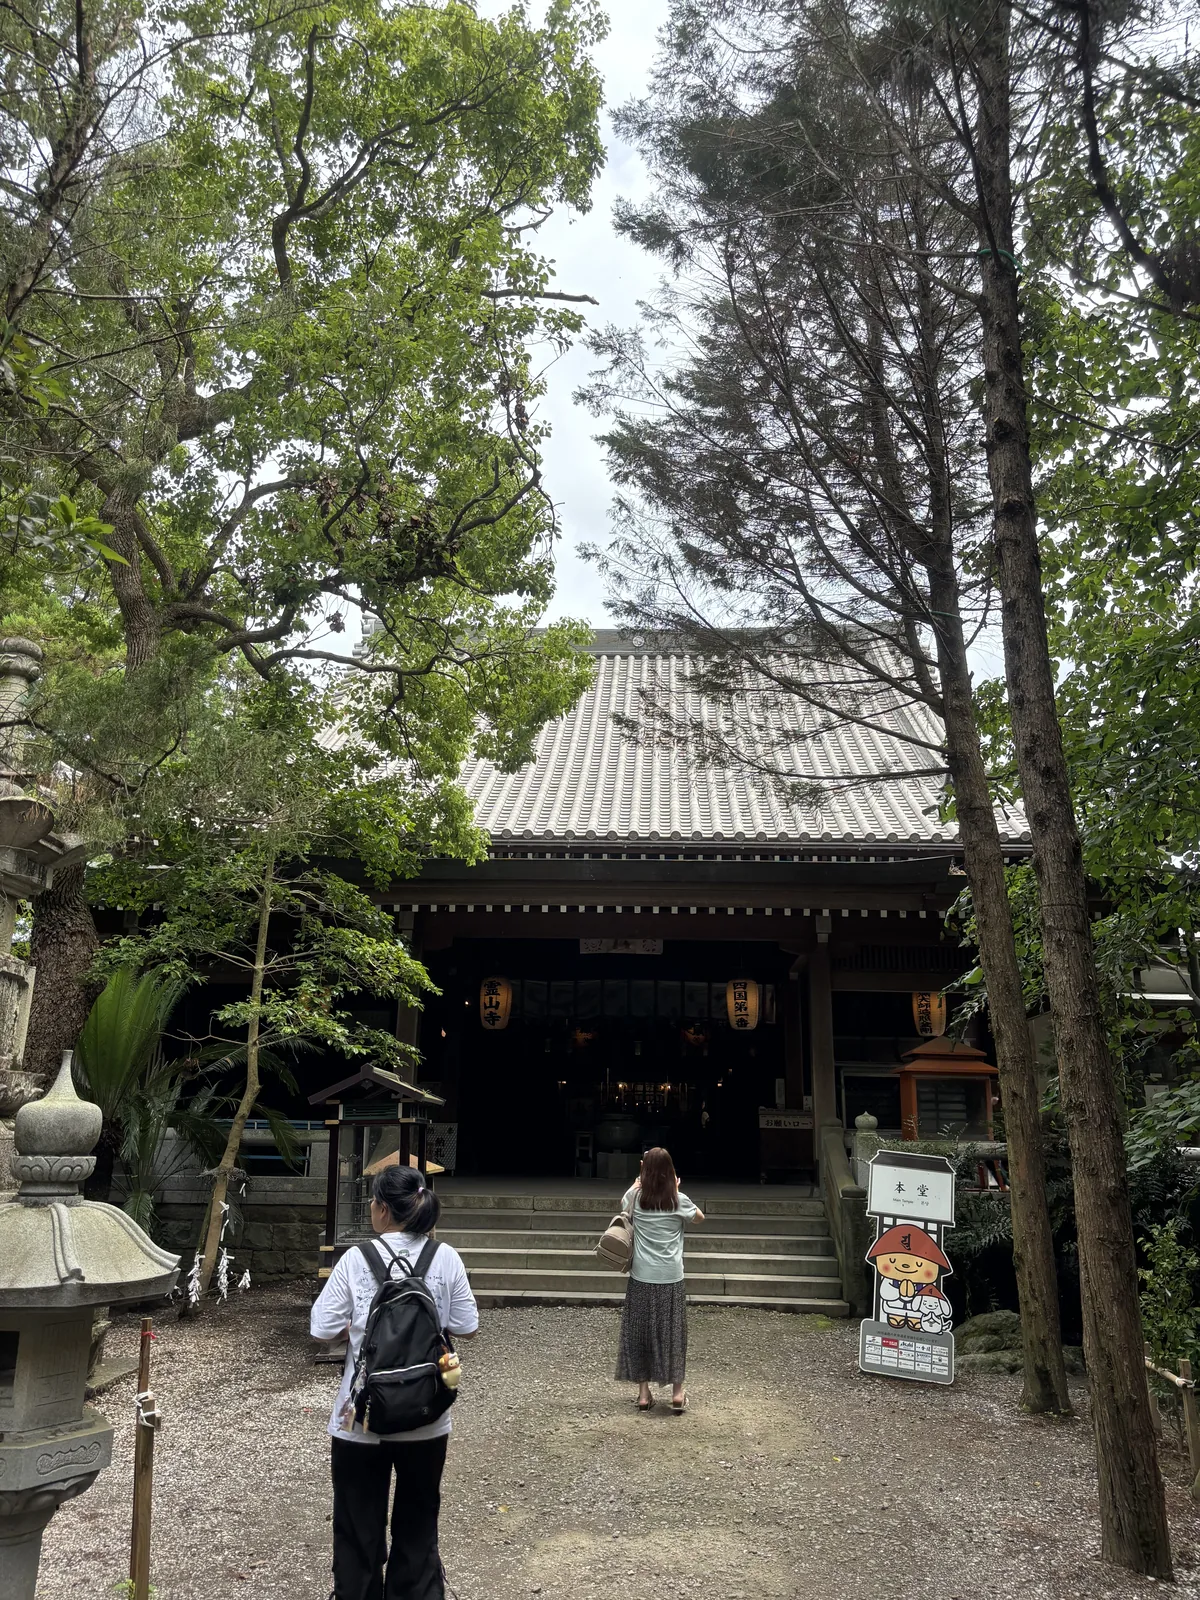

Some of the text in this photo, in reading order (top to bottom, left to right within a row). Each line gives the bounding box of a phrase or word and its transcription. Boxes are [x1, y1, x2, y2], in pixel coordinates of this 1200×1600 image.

[484, 980, 501, 1027] 霊山寺
[733, 982, 749, 1027] 四国第一番
[765, 1119, 813, 1127] お願いロー
[894, 1181, 929, 1197] 本堂
